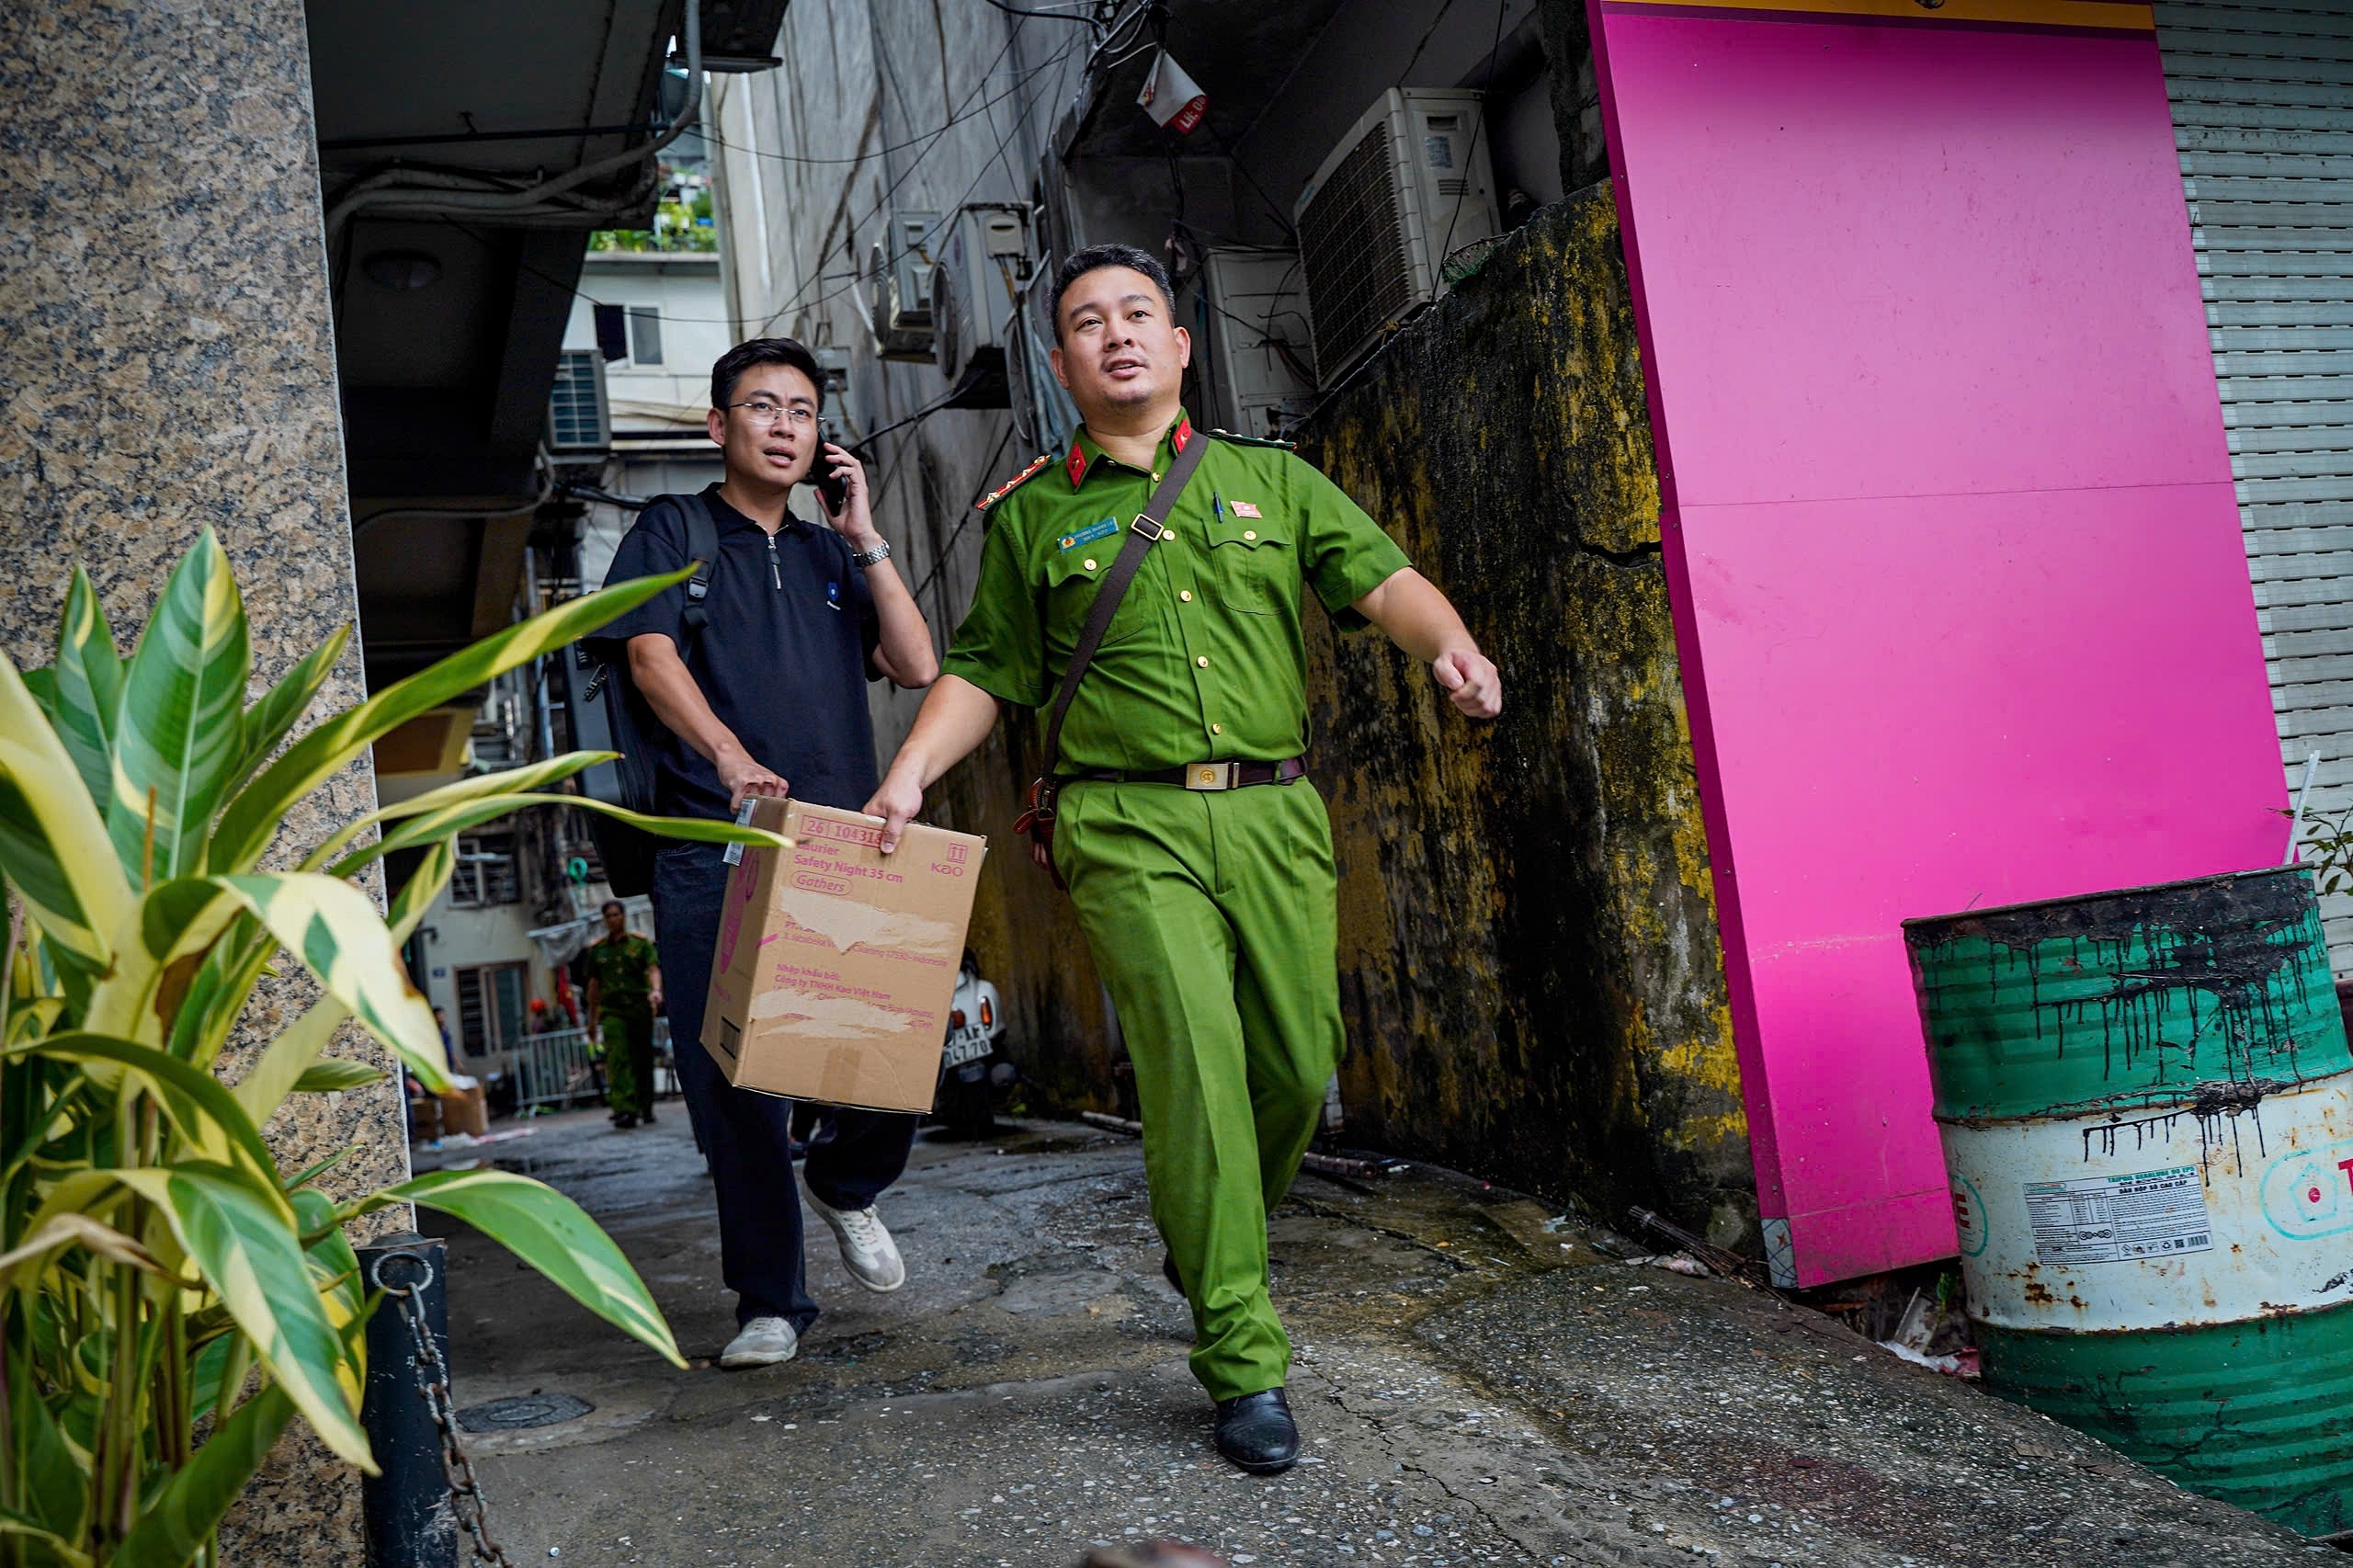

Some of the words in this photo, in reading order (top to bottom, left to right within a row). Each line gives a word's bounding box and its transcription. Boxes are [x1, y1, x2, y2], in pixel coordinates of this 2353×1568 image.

[794, 854, 832, 871] Safety
[835, 861, 867, 877] Night
[869, 868, 884, 880] 35
[885, 873, 903, 882] cm
[797, 874, 846, 892] Gathers
